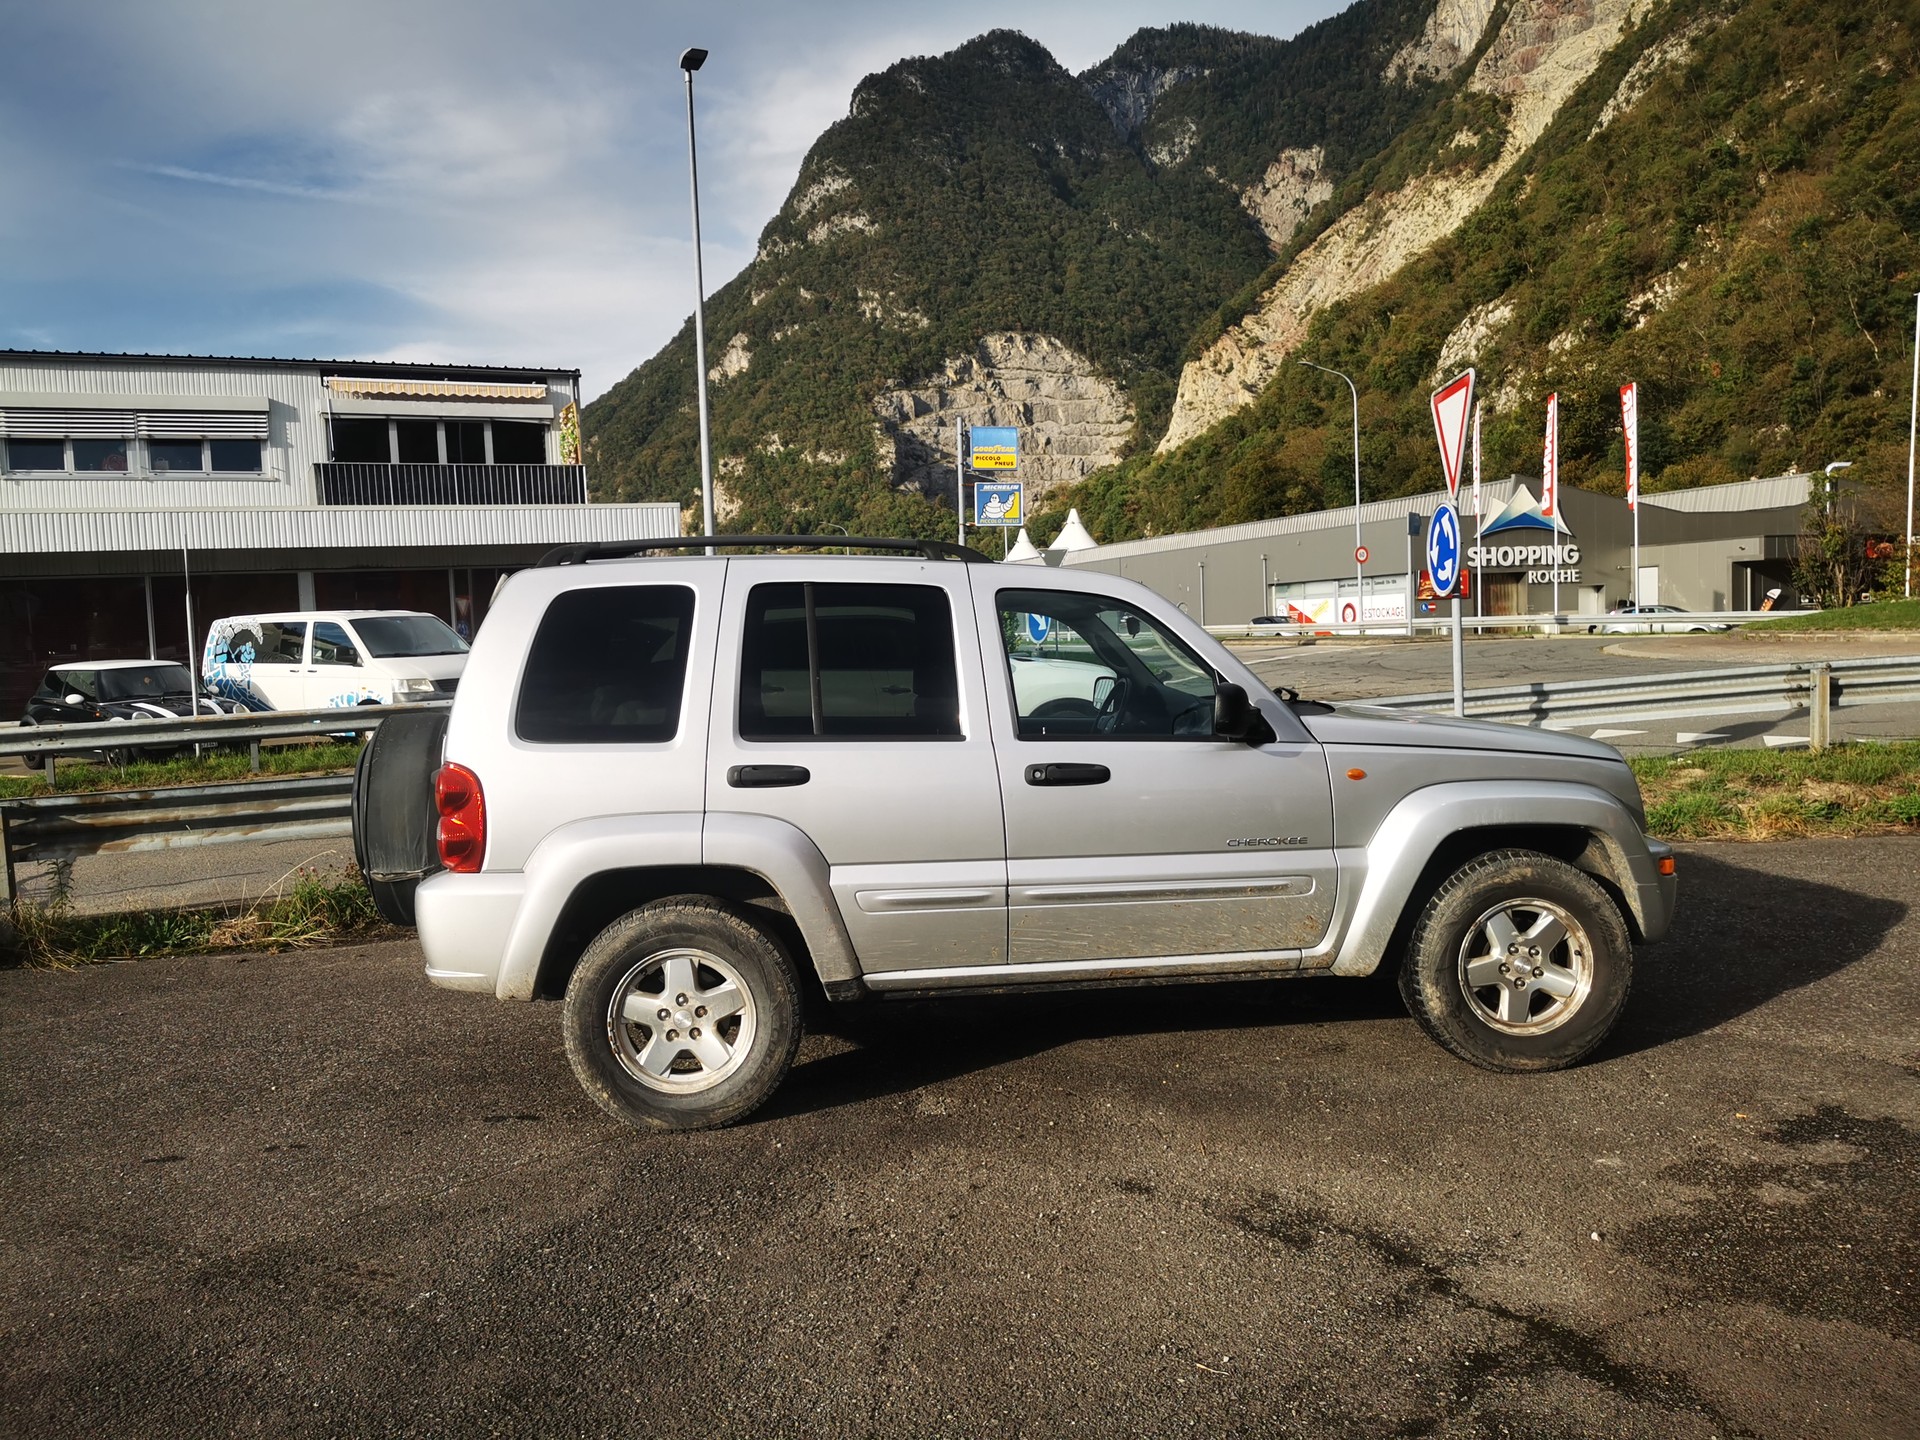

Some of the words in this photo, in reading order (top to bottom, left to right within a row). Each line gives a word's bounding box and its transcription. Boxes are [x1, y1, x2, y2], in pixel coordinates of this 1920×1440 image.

[973, 445, 1016, 454] GOODYEAR
[1467, 544, 1580, 567] SHOPPING
[1528, 569, 1580, 584] ROCHE
[1227, 837, 1309, 847] CHEROKEE
